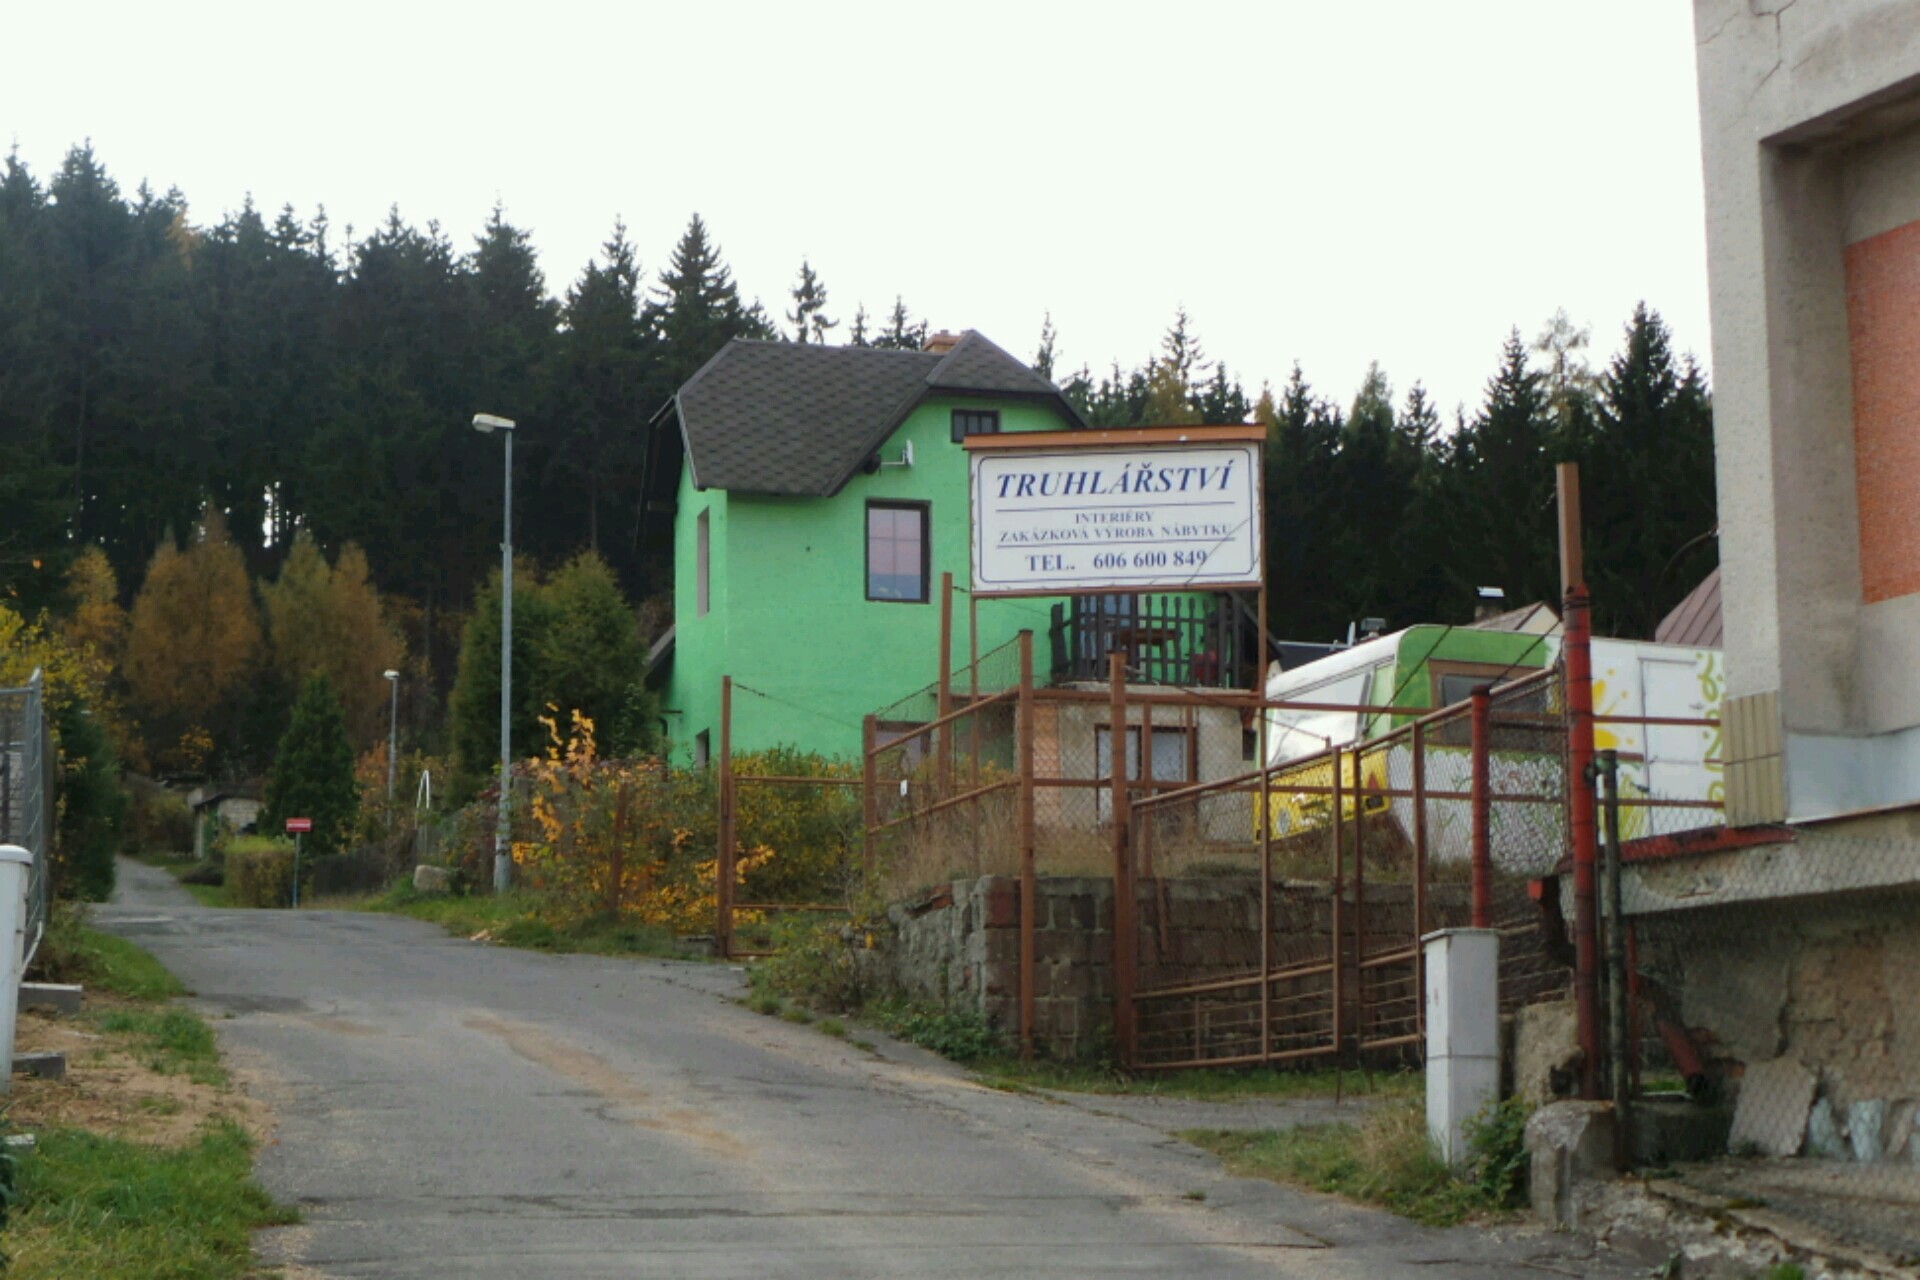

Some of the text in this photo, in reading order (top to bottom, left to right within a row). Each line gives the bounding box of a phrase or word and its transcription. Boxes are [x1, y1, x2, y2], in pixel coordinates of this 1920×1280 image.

[997, 459, 1235, 498] TRUHLÁŘSTVÍ
[1075, 511, 1154, 525] INTERIÉRY
[1094, 526, 1154, 539] VÝROBA
[1161, 523, 1232, 537] NÁBYTKU
[1093, 552, 1127, 570] 606
[1133, 551, 1167, 568] 600
[1173, 549, 1208, 566] 849
